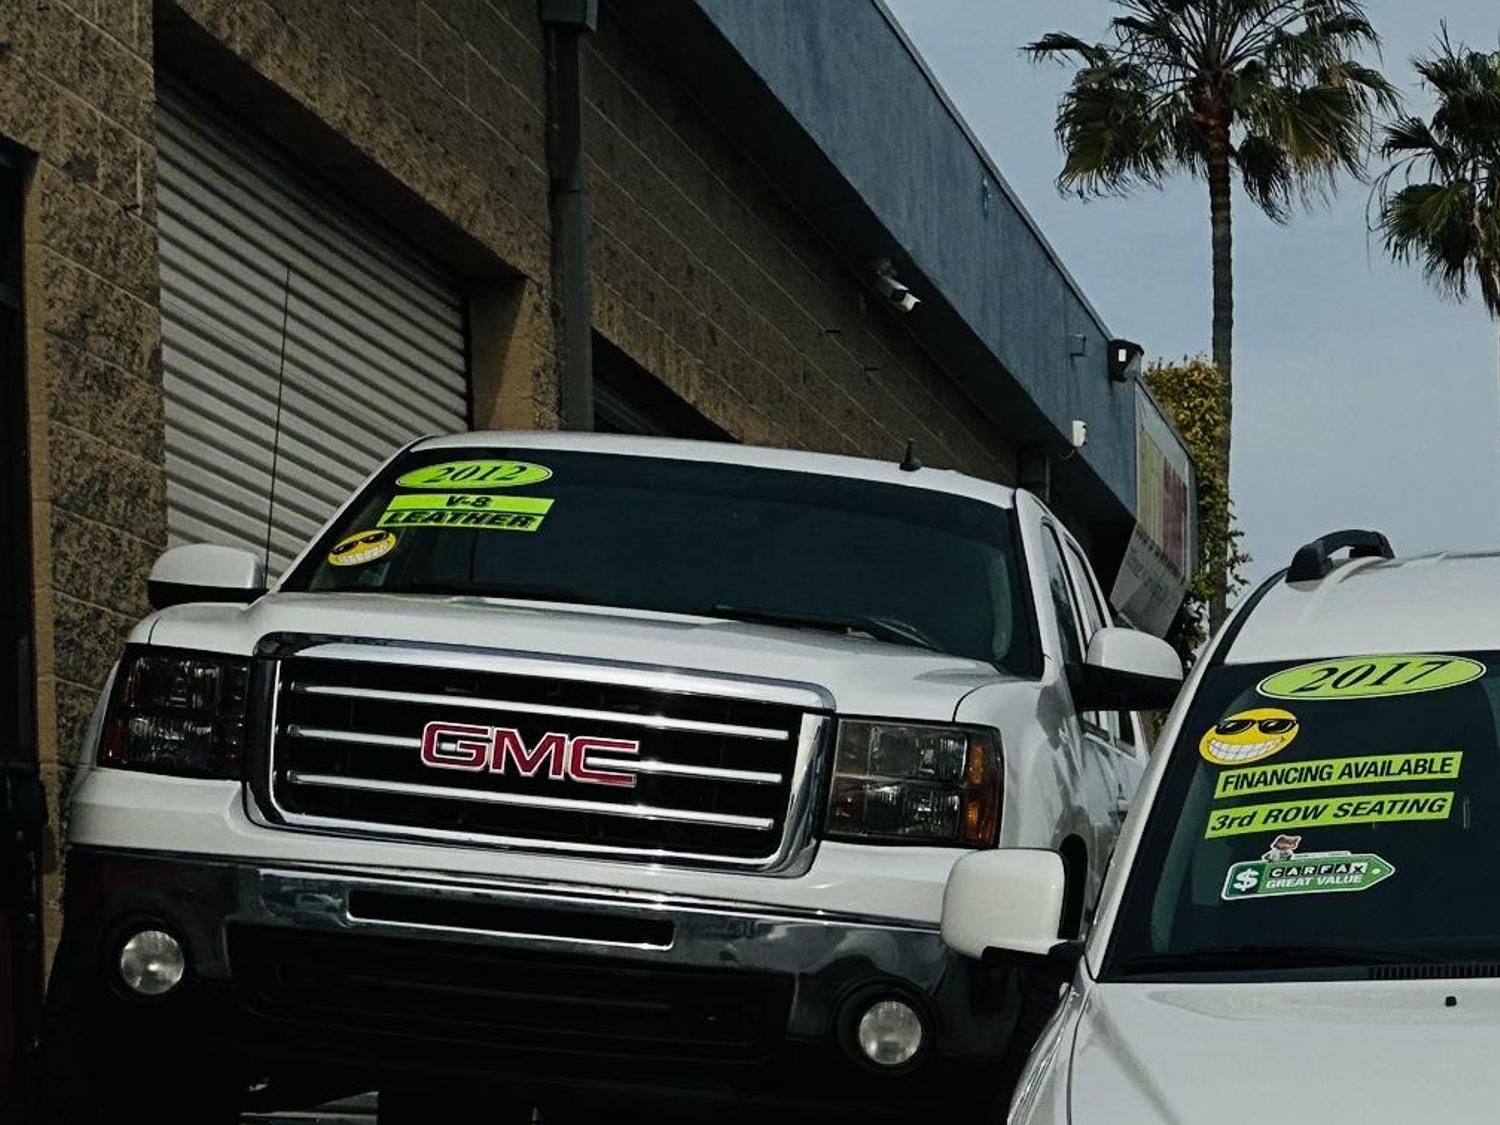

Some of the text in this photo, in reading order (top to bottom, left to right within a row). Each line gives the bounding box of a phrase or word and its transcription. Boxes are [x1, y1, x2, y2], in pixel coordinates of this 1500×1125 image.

[422, 464, 528, 484] 2012
[445, 496, 493, 508] V-8
[384, 511, 536, 527] LEATHER
[1290, 660, 1454, 694] 2017
[420, 721, 640, 788] GMC
[1221, 756, 1454, 793] FINANCING AVAILABLE
[1210, 797, 1448, 832] 3rd ROW SEATING
[1269, 862, 1368, 878] CARFAX
[1266, 874, 1364, 889] GREAT VALUE
